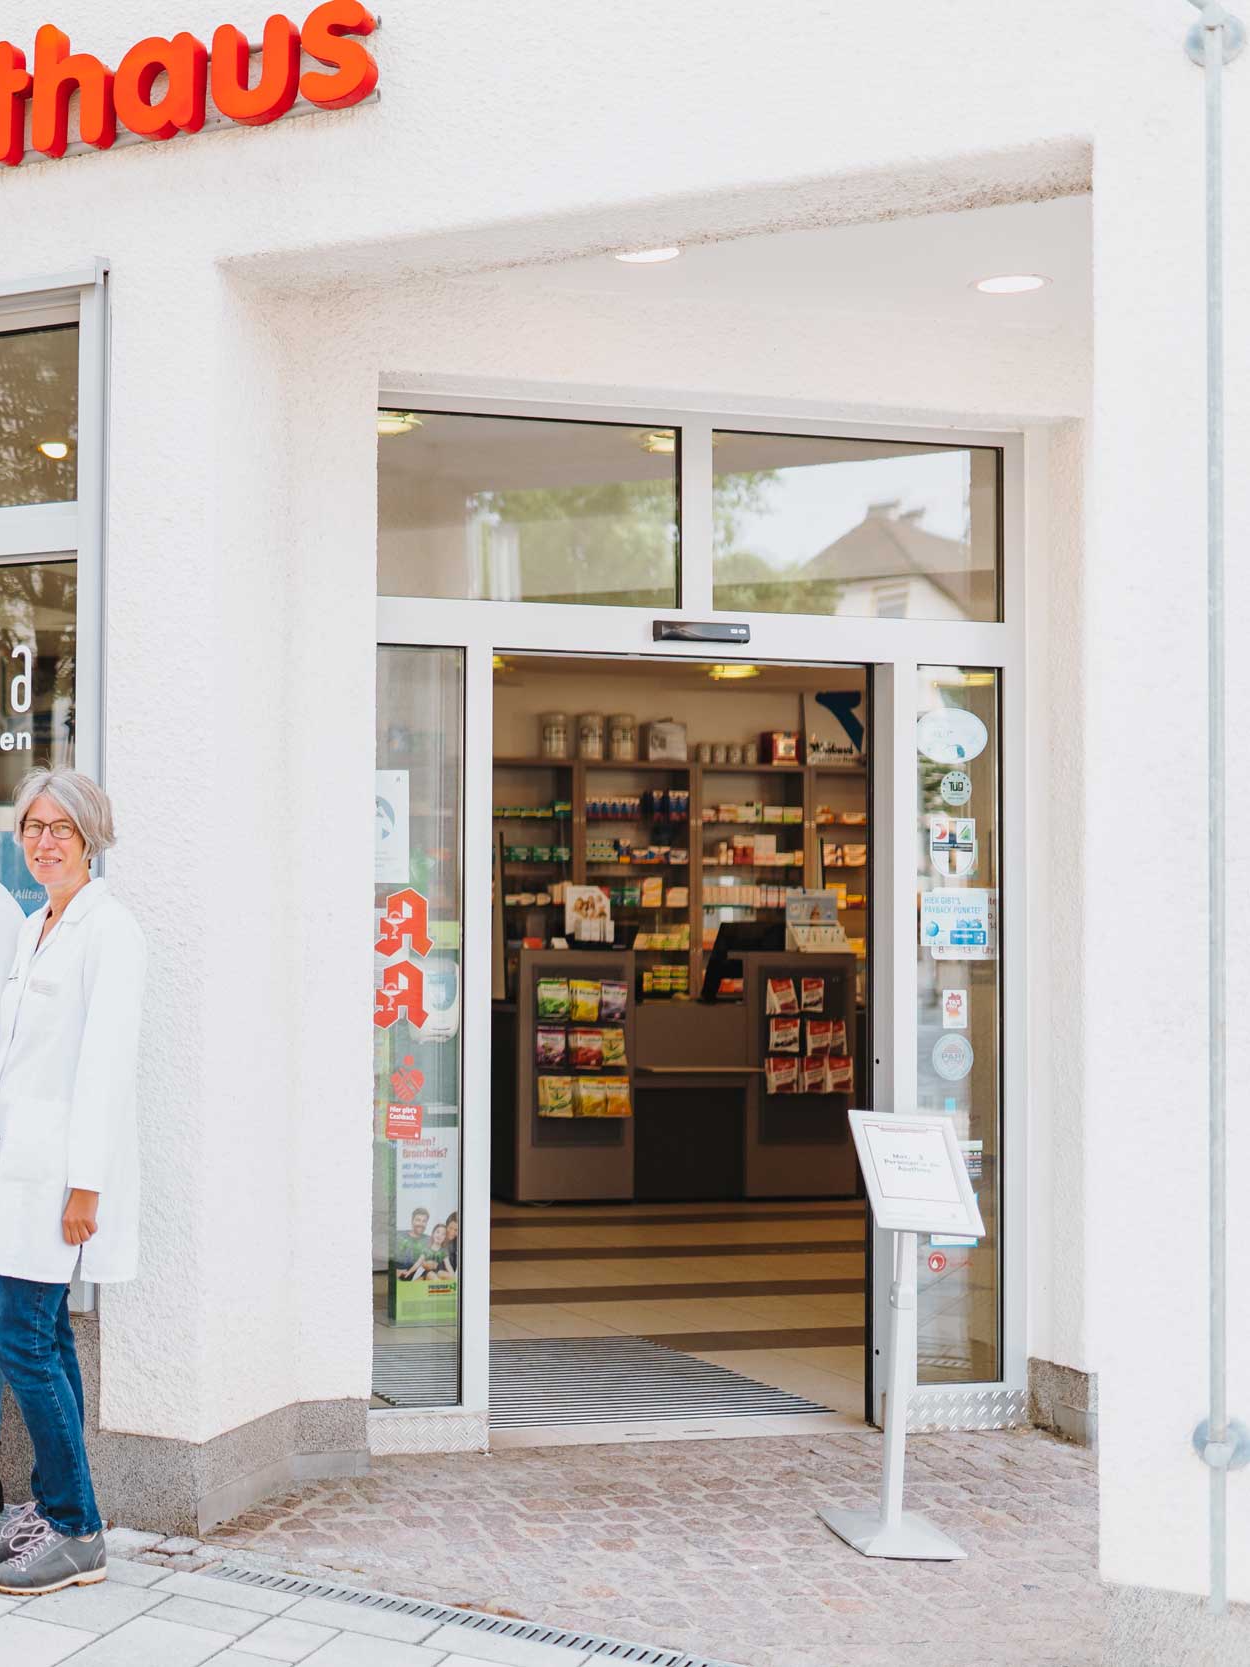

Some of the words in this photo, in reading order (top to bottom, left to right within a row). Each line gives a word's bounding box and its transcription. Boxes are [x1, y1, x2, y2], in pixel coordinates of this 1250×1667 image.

[389, 1105, 402, 1114] Hier
[402, 1106, 418, 1115] gibt's
[389, 1113, 417, 1121] Cashback.
